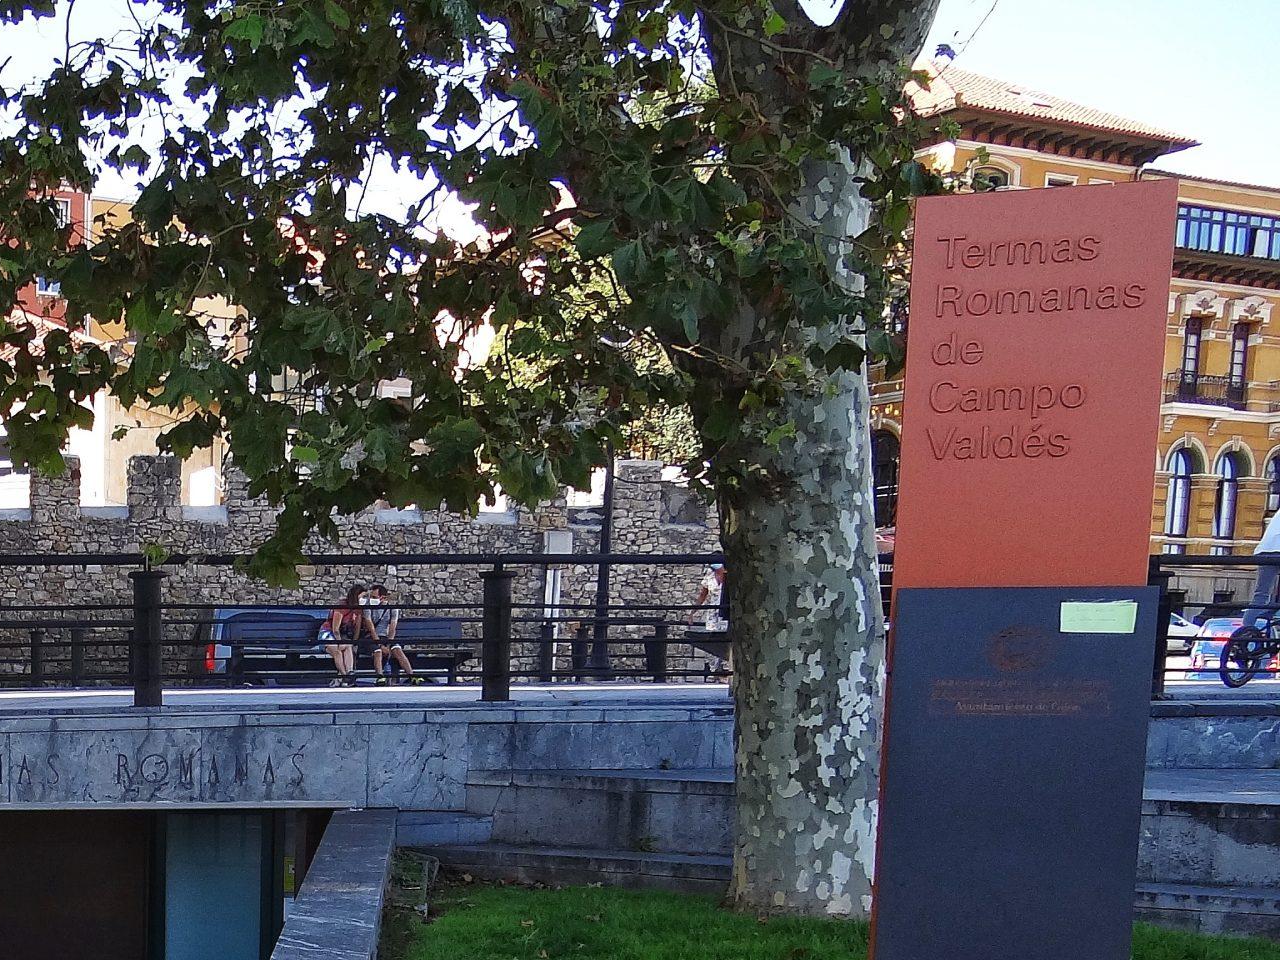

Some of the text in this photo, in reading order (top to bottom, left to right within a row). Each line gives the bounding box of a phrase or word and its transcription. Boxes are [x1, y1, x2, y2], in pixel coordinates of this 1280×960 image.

[937, 234, 1102, 270] Termas
[935, 283, 1147, 318] Romanas
[931, 331, 985, 366] de
[928, 381, 1087, 420] Campo
[925, 424, 1071, 461] Valdés
[114, 753, 305, 787] ROMANAS
